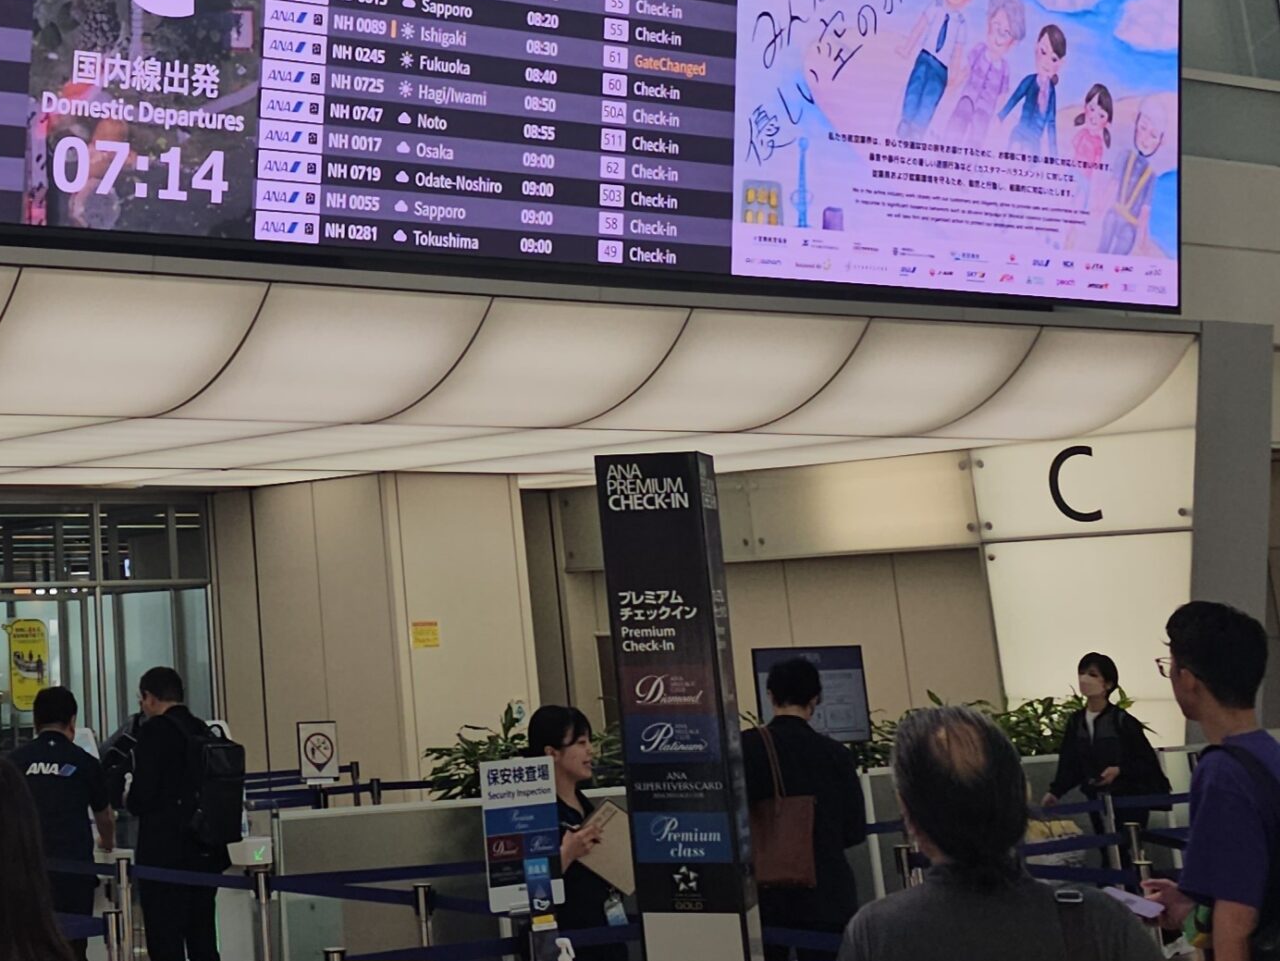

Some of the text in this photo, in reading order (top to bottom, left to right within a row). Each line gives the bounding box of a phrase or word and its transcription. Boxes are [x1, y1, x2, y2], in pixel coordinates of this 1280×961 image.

[72, 50, 220, 98] 国内線出発
[268, 67, 679, 126] ANA NH 0725 Hagi/Iwami 08:50 50A Check-in
[42, 91, 244, 132] Domestic Departures
[52, 136, 228, 204] 07:14
[264, 158, 677, 208] ANA NH 0719 Odate-Noshiro 09:00 503 Check-in
[606, 464, 642, 479] ANA
[606, 477, 684, 495] PREMIUM
[1048, 446, 1102, 522] C
[608, 492, 689, 511] CHECK-IN
[618, 590, 683, 606] プレミアム
[620, 606, 698, 621] チェックイン
[621, 626, 676, 638] Premium
[622, 640, 675, 652] Check-In
[640, 722, 708, 752] Platinum
[26, 762, 59, 776] ANA
[487, 764, 549, 785] 保安検査場
[666, 772, 688, 780] ANA
[488, 787, 552, 800] Security Inspection
[651, 816, 721, 842] Premium
[670, 845, 706, 858] class
